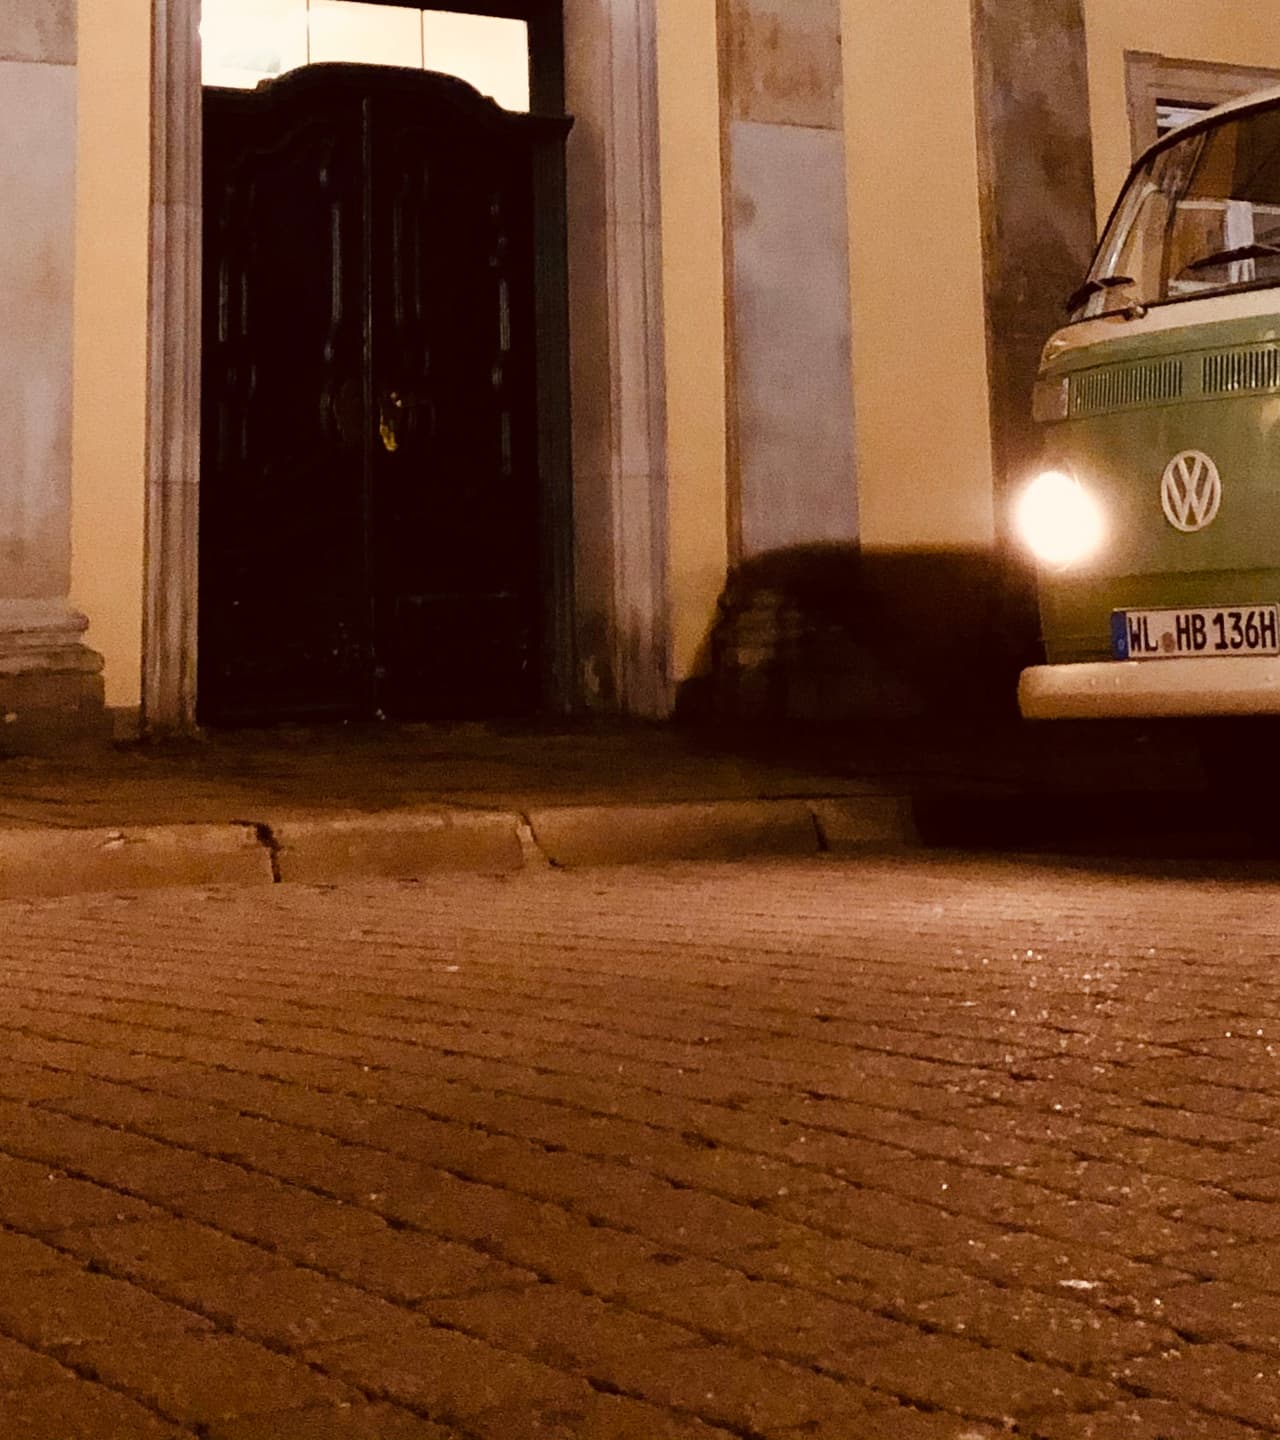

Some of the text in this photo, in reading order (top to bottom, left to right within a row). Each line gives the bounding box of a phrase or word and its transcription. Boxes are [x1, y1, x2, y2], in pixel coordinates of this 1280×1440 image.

[1161, 449, 1221, 532] VW
[1128, 611, 1277, 652] WL HB 136H
